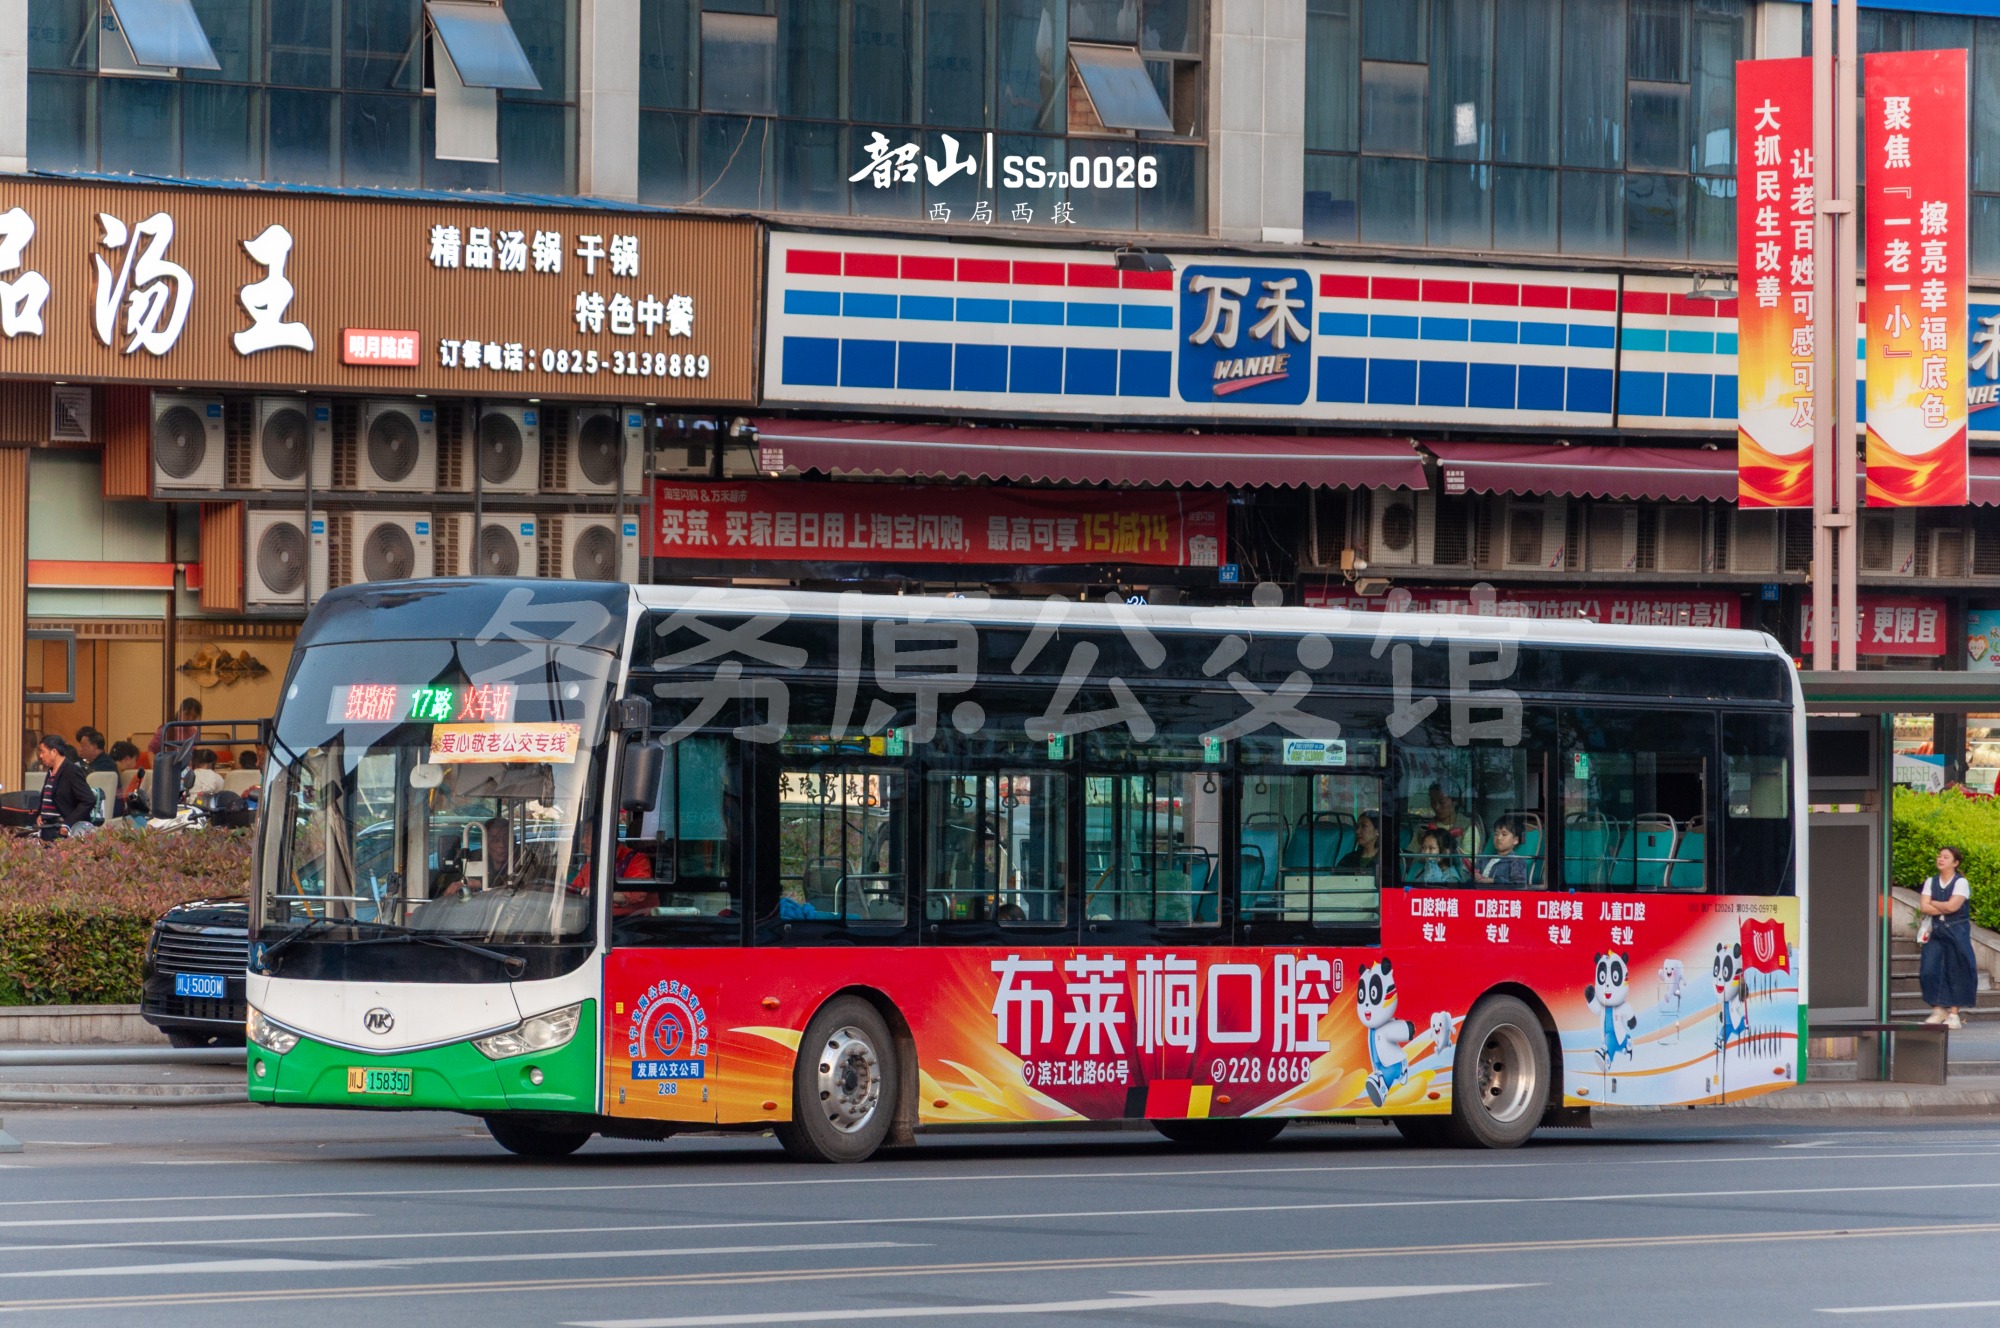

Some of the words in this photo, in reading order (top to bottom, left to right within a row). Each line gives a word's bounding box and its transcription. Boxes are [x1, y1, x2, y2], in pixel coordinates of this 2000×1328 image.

[1754, 99, 1781, 308] 大抓民生改善
[430, 224, 562, 273] 精品汤锅
[576, 234, 639, 277] 干锅
[1790, 149, 1814, 428] 让老百姓可感可及
[575, 291, 694, 338] 特色中餐
[1188, 275, 1310, 349] 万禾
[1920, 201, 1948, 429] 擦亮幸福底色
[349, 335, 414, 359] 明月路店
[1213, 354, 1290, 380] WANHE
[1872, 607, 1938, 643] 更便宜
[345, 684, 396, 720] 铁路桥
[411, 688, 452, 721] 17路
[457, 684, 511, 720] 火车站
[440, 732, 566, 753] 爱心敬老公交专线
[1895, 766, 1931, 782] FRESH
[1411, 897, 1459, 917] 口腔种植
[1475, 898, 1522, 919] 口腔正畸
[1537, 900, 1583, 920] 口腔修复
[1599, 901, 1645, 921] 儿童口腔
[1422, 922, 1446, 942] 专业
[1486, 923, 1509, 943] 专业
[1548, 924, 1571, 944] 专业
[1610, 926, 1633, 945] 专业
[991, 953, 1331, 1056] 布莱梅口腔
[637, 1062, 699, 1077] 发展公交公司
[1037, 1059, 1129, 1085] 滨江北路66号
[1229, 1057, 1261, 1083] 228
[1267, 1057, 1310, 1083] 6868
[658, 1083, 677, 1095] 288
